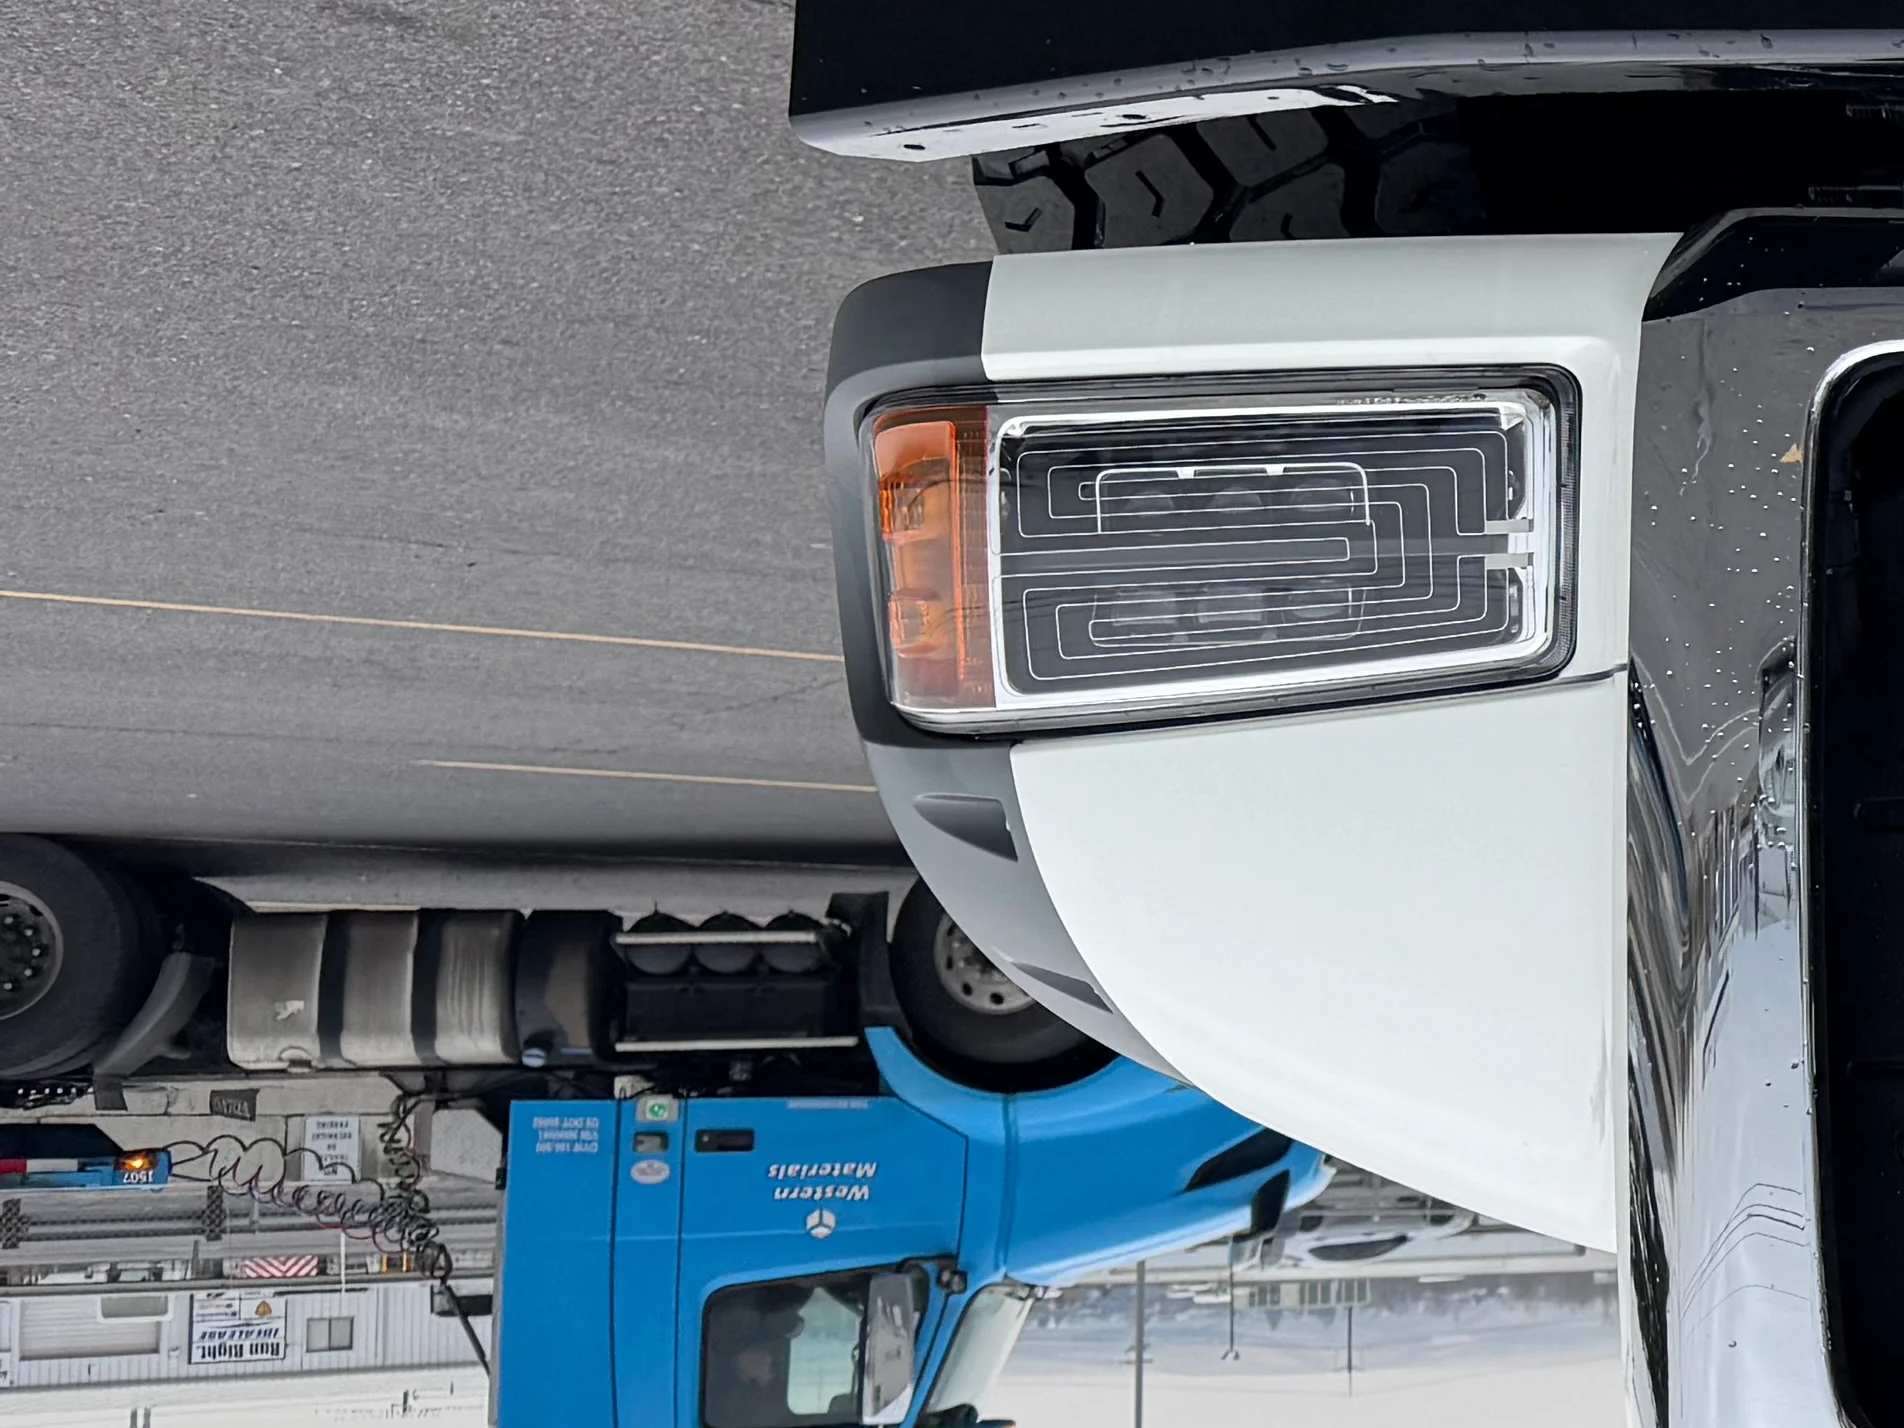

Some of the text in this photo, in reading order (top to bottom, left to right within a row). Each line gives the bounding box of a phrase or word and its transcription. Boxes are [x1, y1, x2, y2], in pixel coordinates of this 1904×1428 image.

[767, 1161, 877, 1180] Materials
[774, 1184, 870, 1201] Western
[249, 1342, 280, 1357] Run
